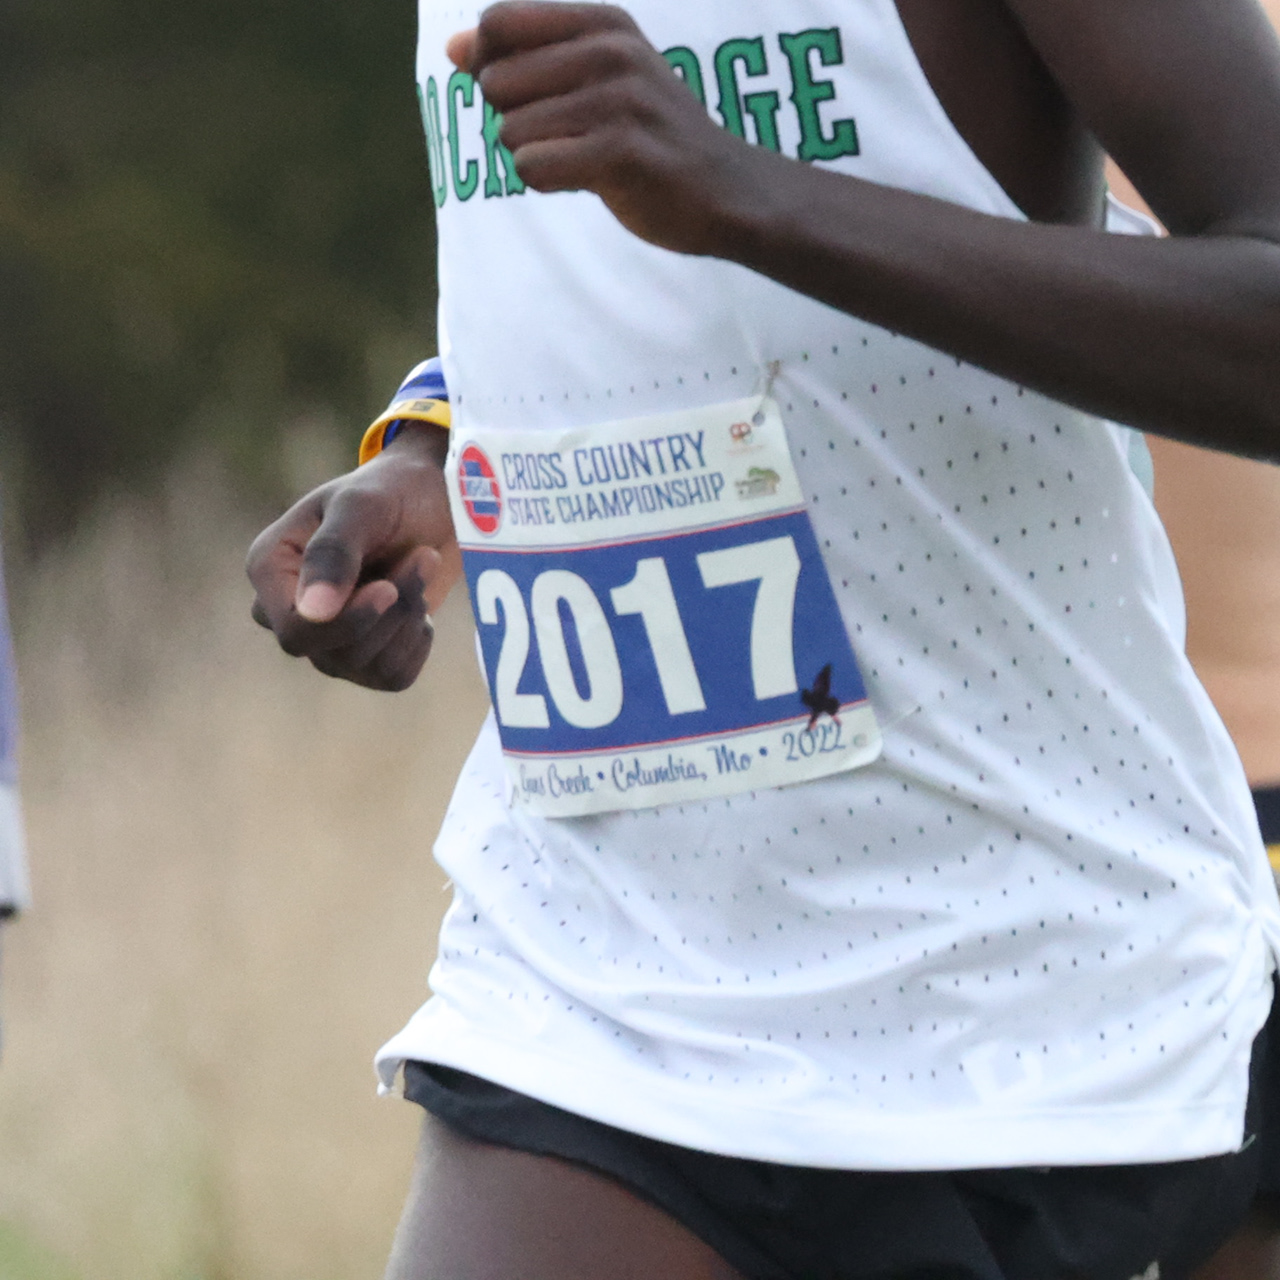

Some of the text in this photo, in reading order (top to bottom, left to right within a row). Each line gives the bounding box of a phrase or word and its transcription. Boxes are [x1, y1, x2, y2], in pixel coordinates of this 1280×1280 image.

[416, 68, 526, 208] OCK
[502, 452, 567, 490] CROSS
[574, 430, 706, 486] COUNTRY
[507, 496, 556, 526] STATE
[556, 471, 726, 524] CHAMPIONSHIP
[476, 535, 801, 730] 2017
[782, 722, 846, 762] 2022
